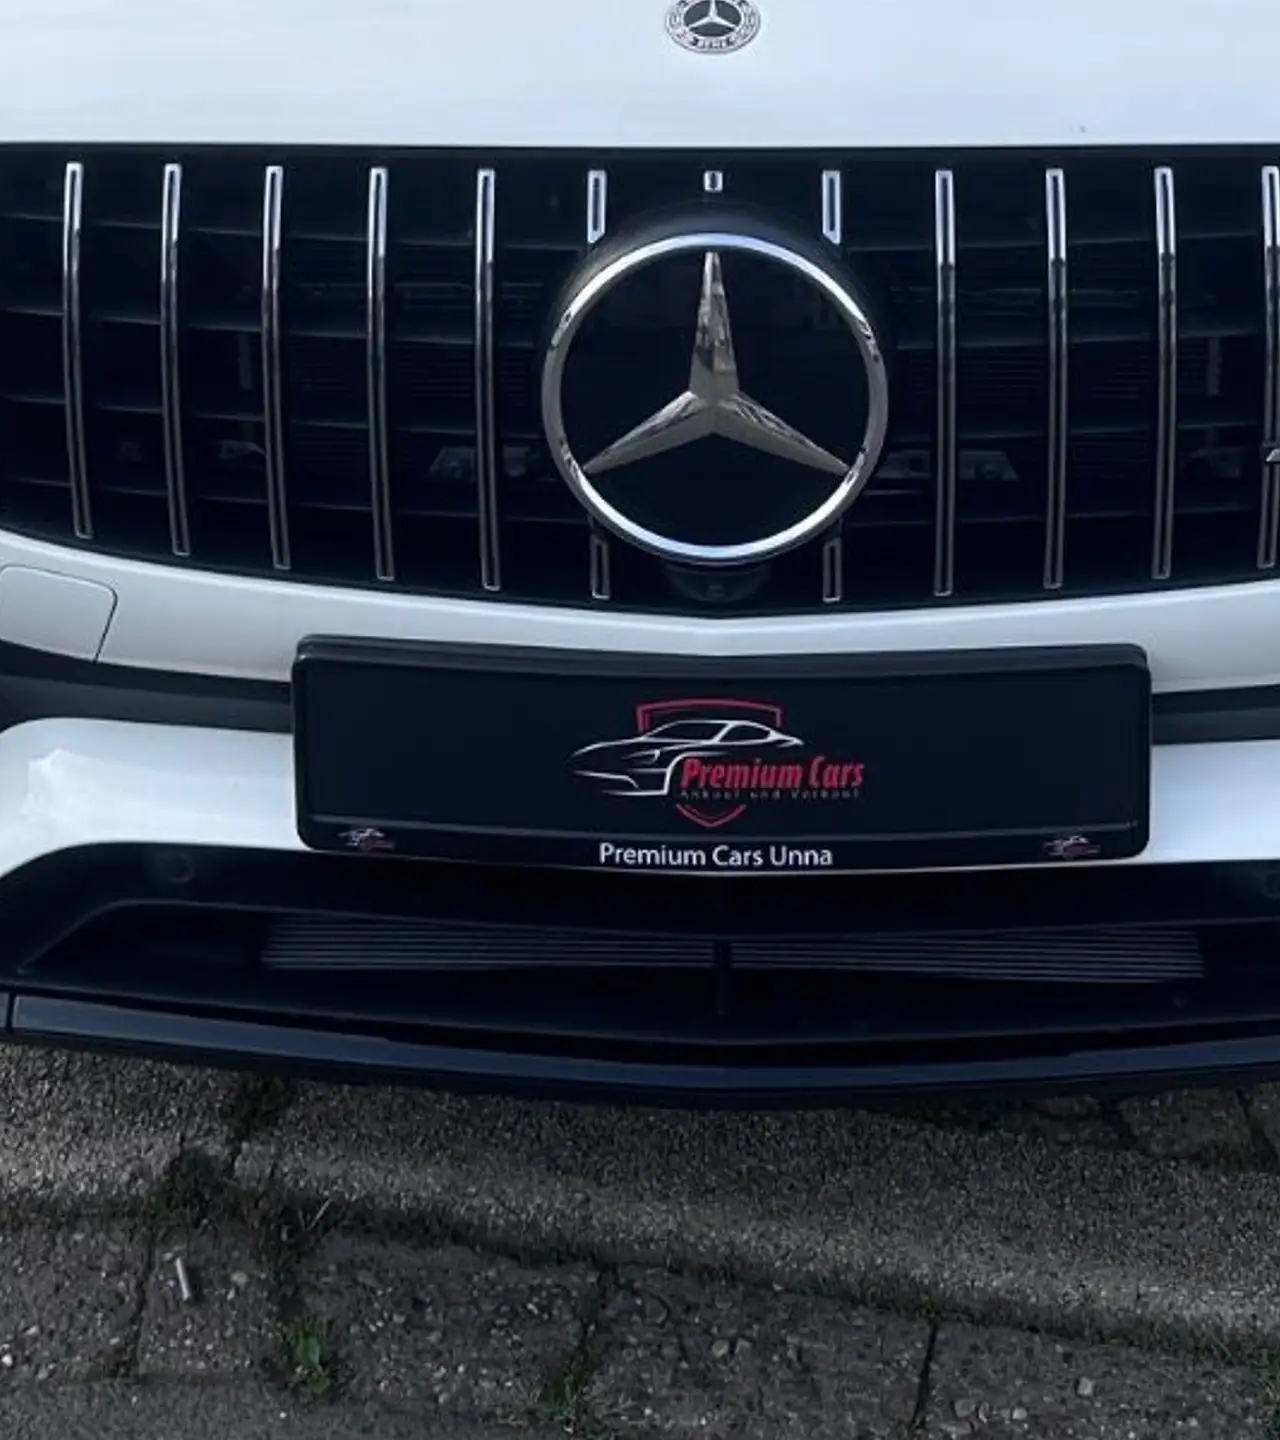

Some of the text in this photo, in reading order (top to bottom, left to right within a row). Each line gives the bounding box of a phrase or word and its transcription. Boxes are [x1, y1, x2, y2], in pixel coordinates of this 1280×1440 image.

[680, 756, 865, 789] Premium Cars
[599, 842, 833, 866] Premium Cars Unna
